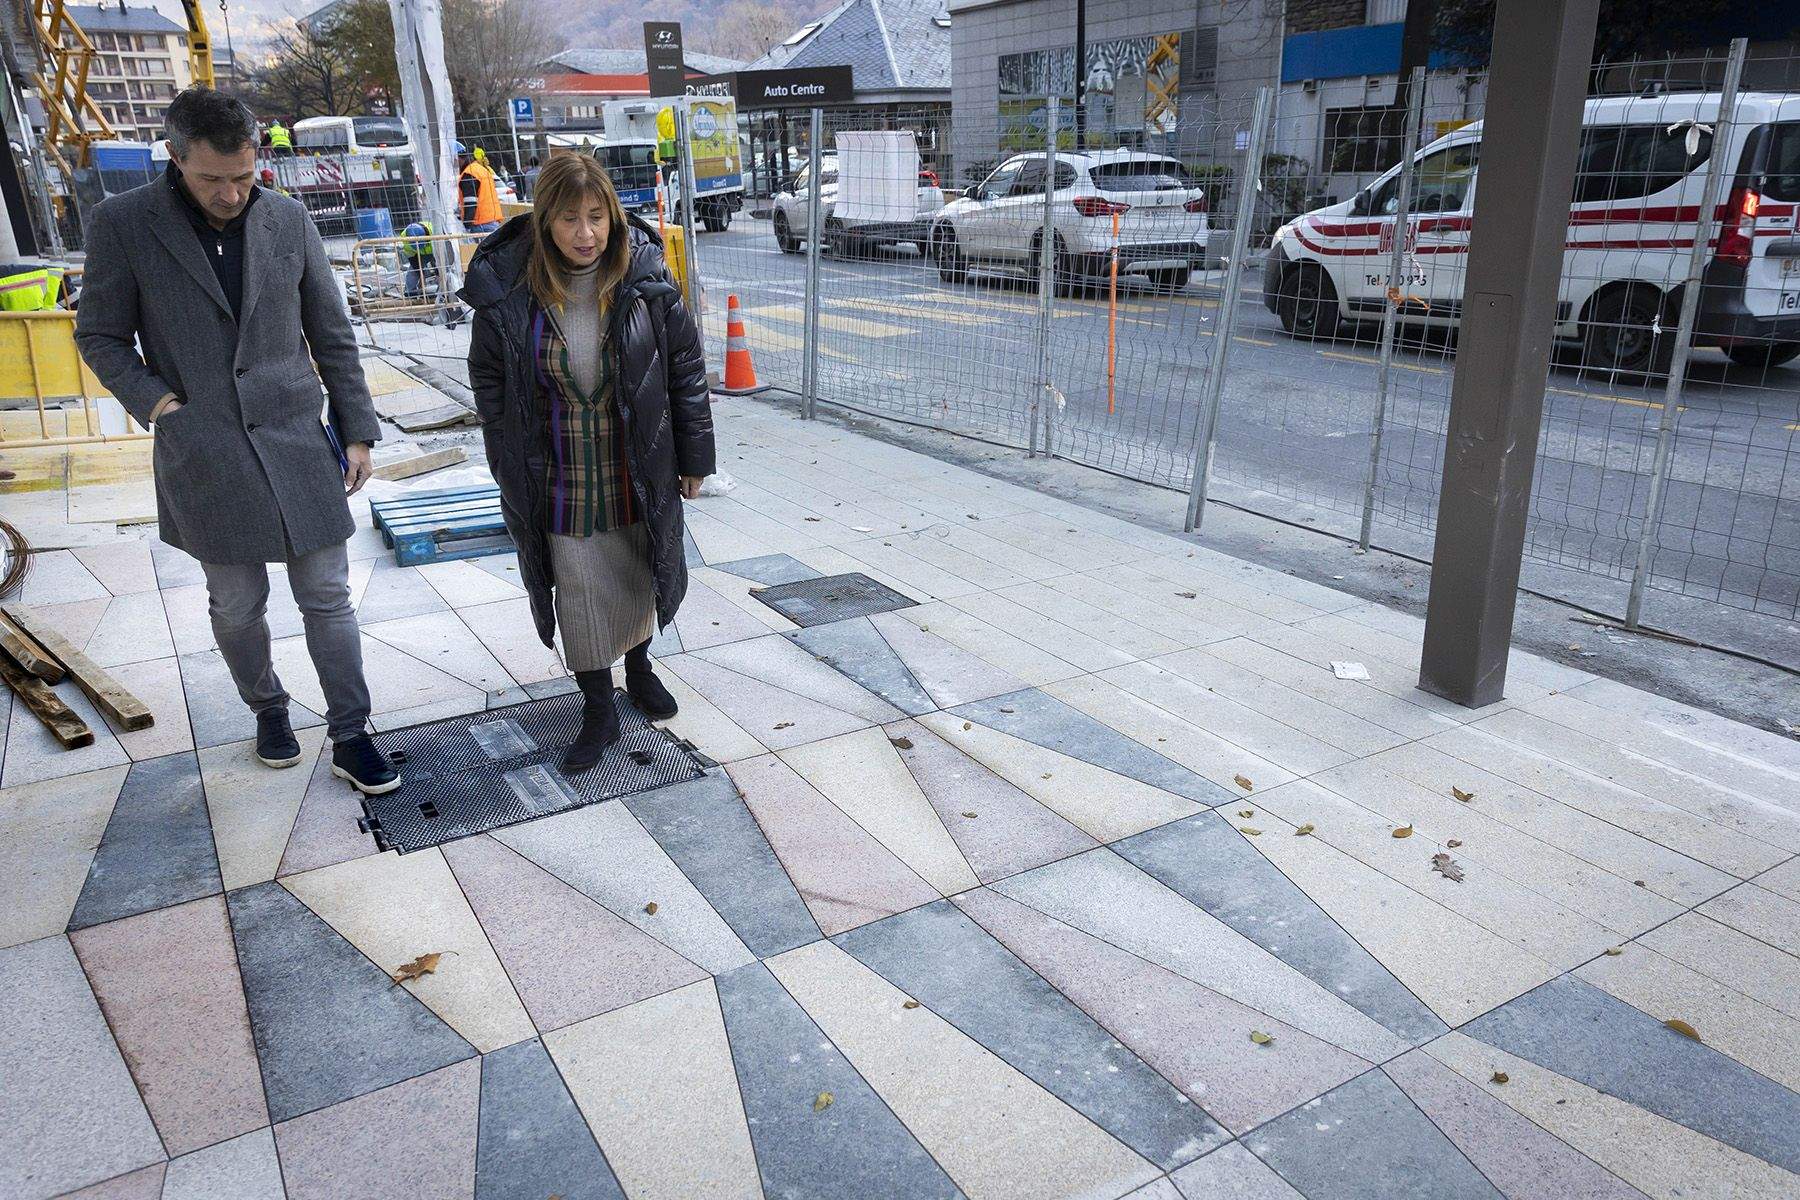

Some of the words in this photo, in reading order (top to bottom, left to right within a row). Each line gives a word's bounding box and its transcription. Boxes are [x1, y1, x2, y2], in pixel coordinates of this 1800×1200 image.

[764, 85, 788, 97] Auto
[791, 83, 825, 96] Centre
[518, 100, 528, 113] P
[1366, 274, 1382, 286] Tel.
